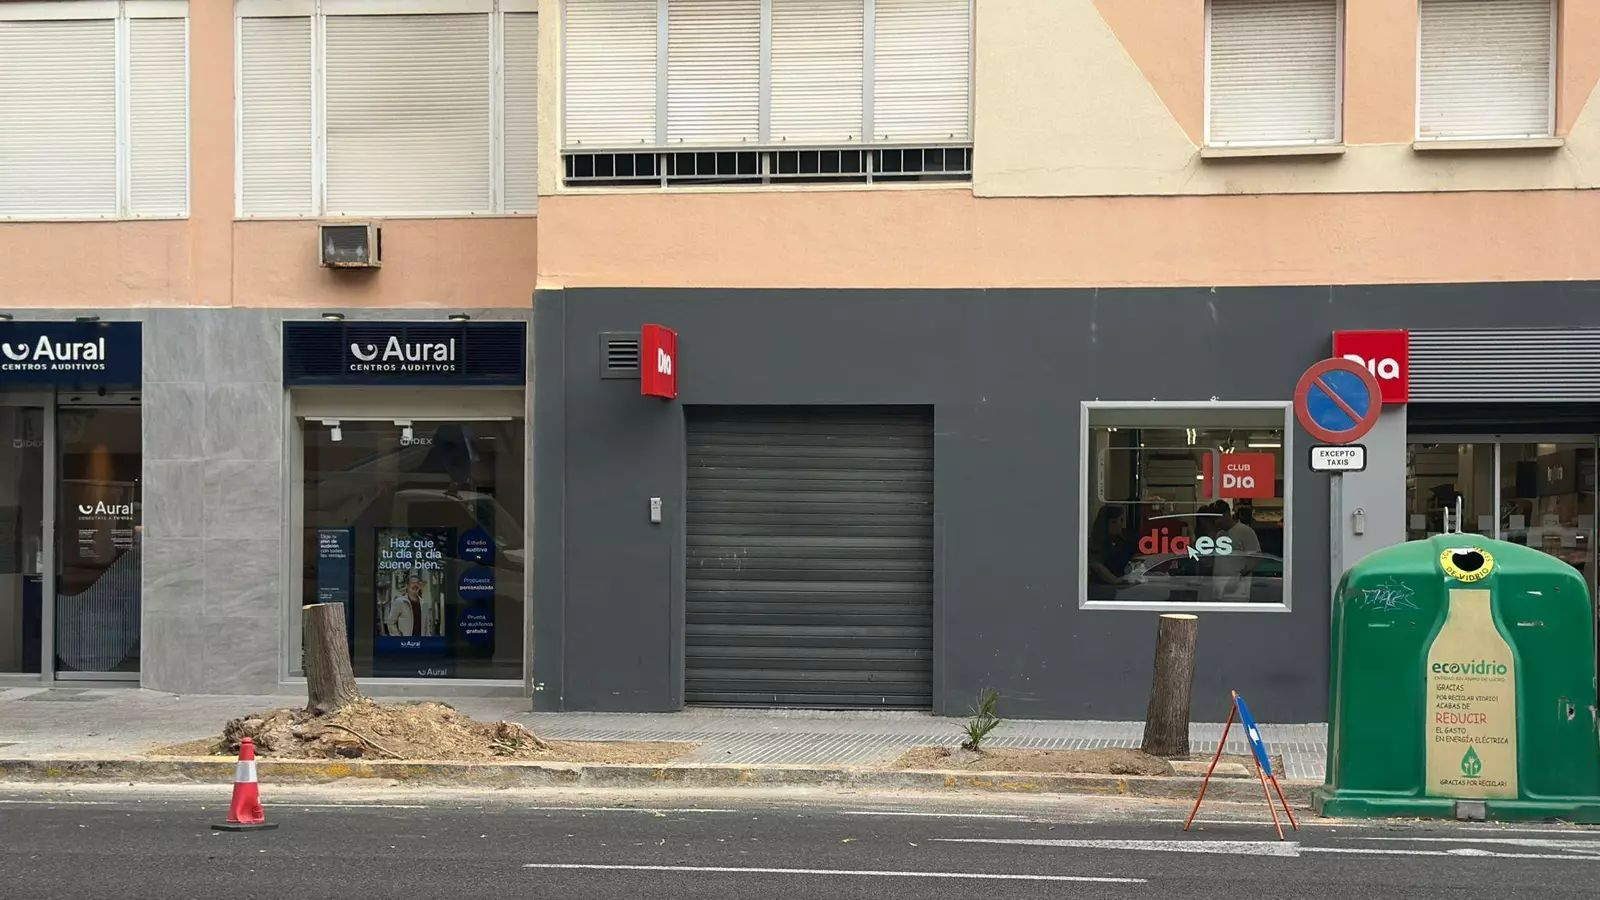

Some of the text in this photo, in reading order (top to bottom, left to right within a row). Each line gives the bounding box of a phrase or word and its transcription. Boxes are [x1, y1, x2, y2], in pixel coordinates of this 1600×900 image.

[33, 335, 105, 361] Aural
[382, 336, 455, 361] Aural
[1227, 463, 1251, 472] CLUB
[95, 500, 134, 515] Aural
[390, 538, 434, 550] Haz que
[382, 548, 442, 559] tu día a día
[380, 560, 441, 569] suene bien.
[1446, 566, 1489, 581] DE VIDRIO
[1432, 659, 1508, 675] ecovidrio
[1435, 712, 1488, 724] REDUCIR
[1435, 726, 1443, 734] EL
[1446, 735, 1473, 743] ENERGÍA
[1475, 736, 1509, 744] ELÉCTRICA
